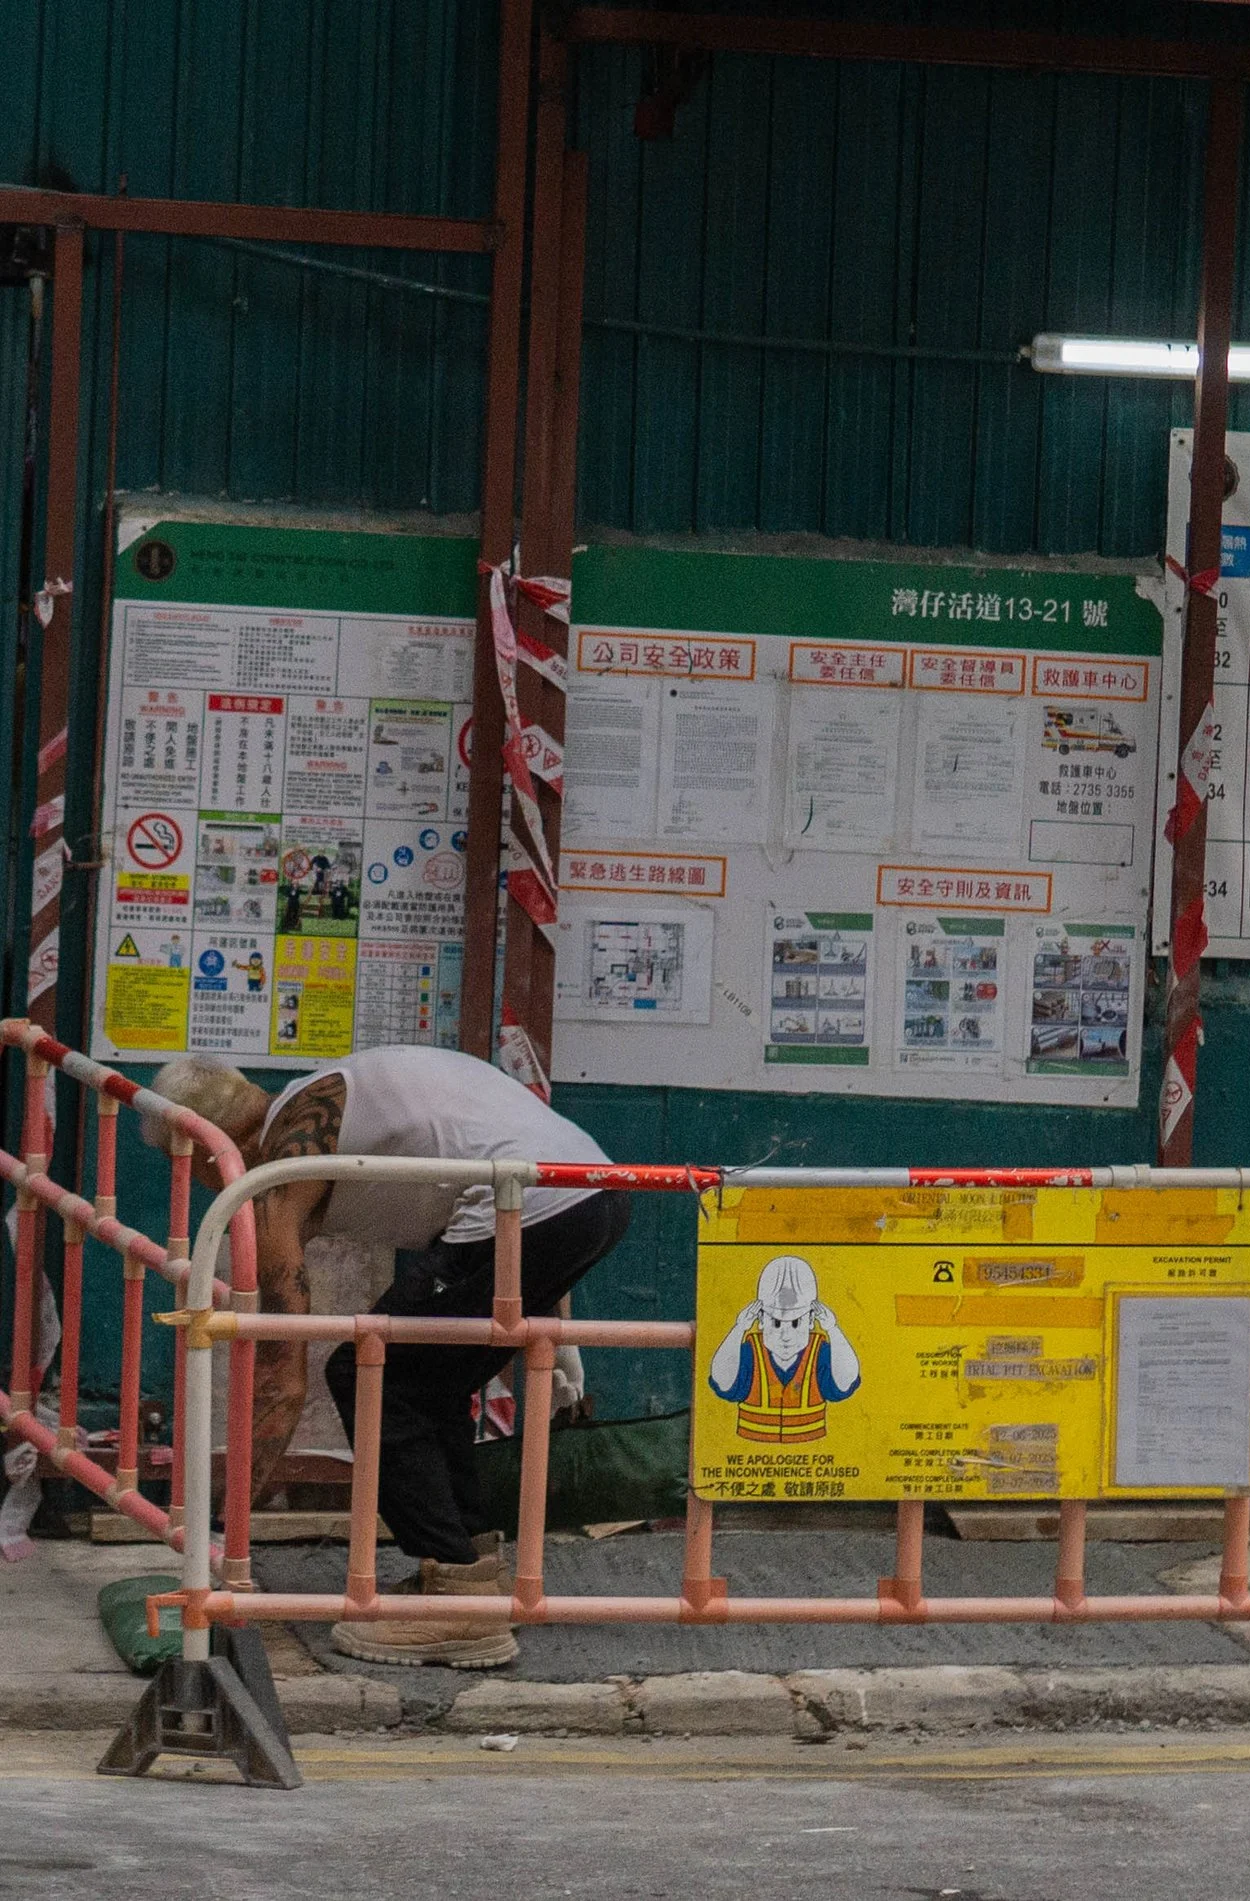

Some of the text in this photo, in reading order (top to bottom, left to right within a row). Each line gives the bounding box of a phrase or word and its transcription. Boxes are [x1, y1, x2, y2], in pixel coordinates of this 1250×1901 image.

[891, 588, 1109, 628] 灣仔活道13-21 號
[593, 642, 741, 671] 公司安全政策
[810, 651, 887, 668] 安全主任
[820, 666, 875, 681] 委任信
[921, 657, 1015, 676] 安全督導員
[939, 673, 996, 687] 委任信
[1042, 668, 1137, 691] 救護車中心
[1058, 763, 1117, 779] 救護車中心
[1107, 784, 1135, 798] 3355
[570, 861, 706, 885] 緊急逃生路線圖
[897, 878, 1032, 901] 安全守則及資訊
[967, 1363, 997, 1375] TRIAL
[1004, 1363, 1024, 1375] PIT
[727, 1455, 834, 1465] WE APOLOGIZE FOR
[701, 1467, 860, 1477] THE INCONVENIENCE CAUSED
[715, 1482, 845, 1497] 不便之處 敬請原諒
